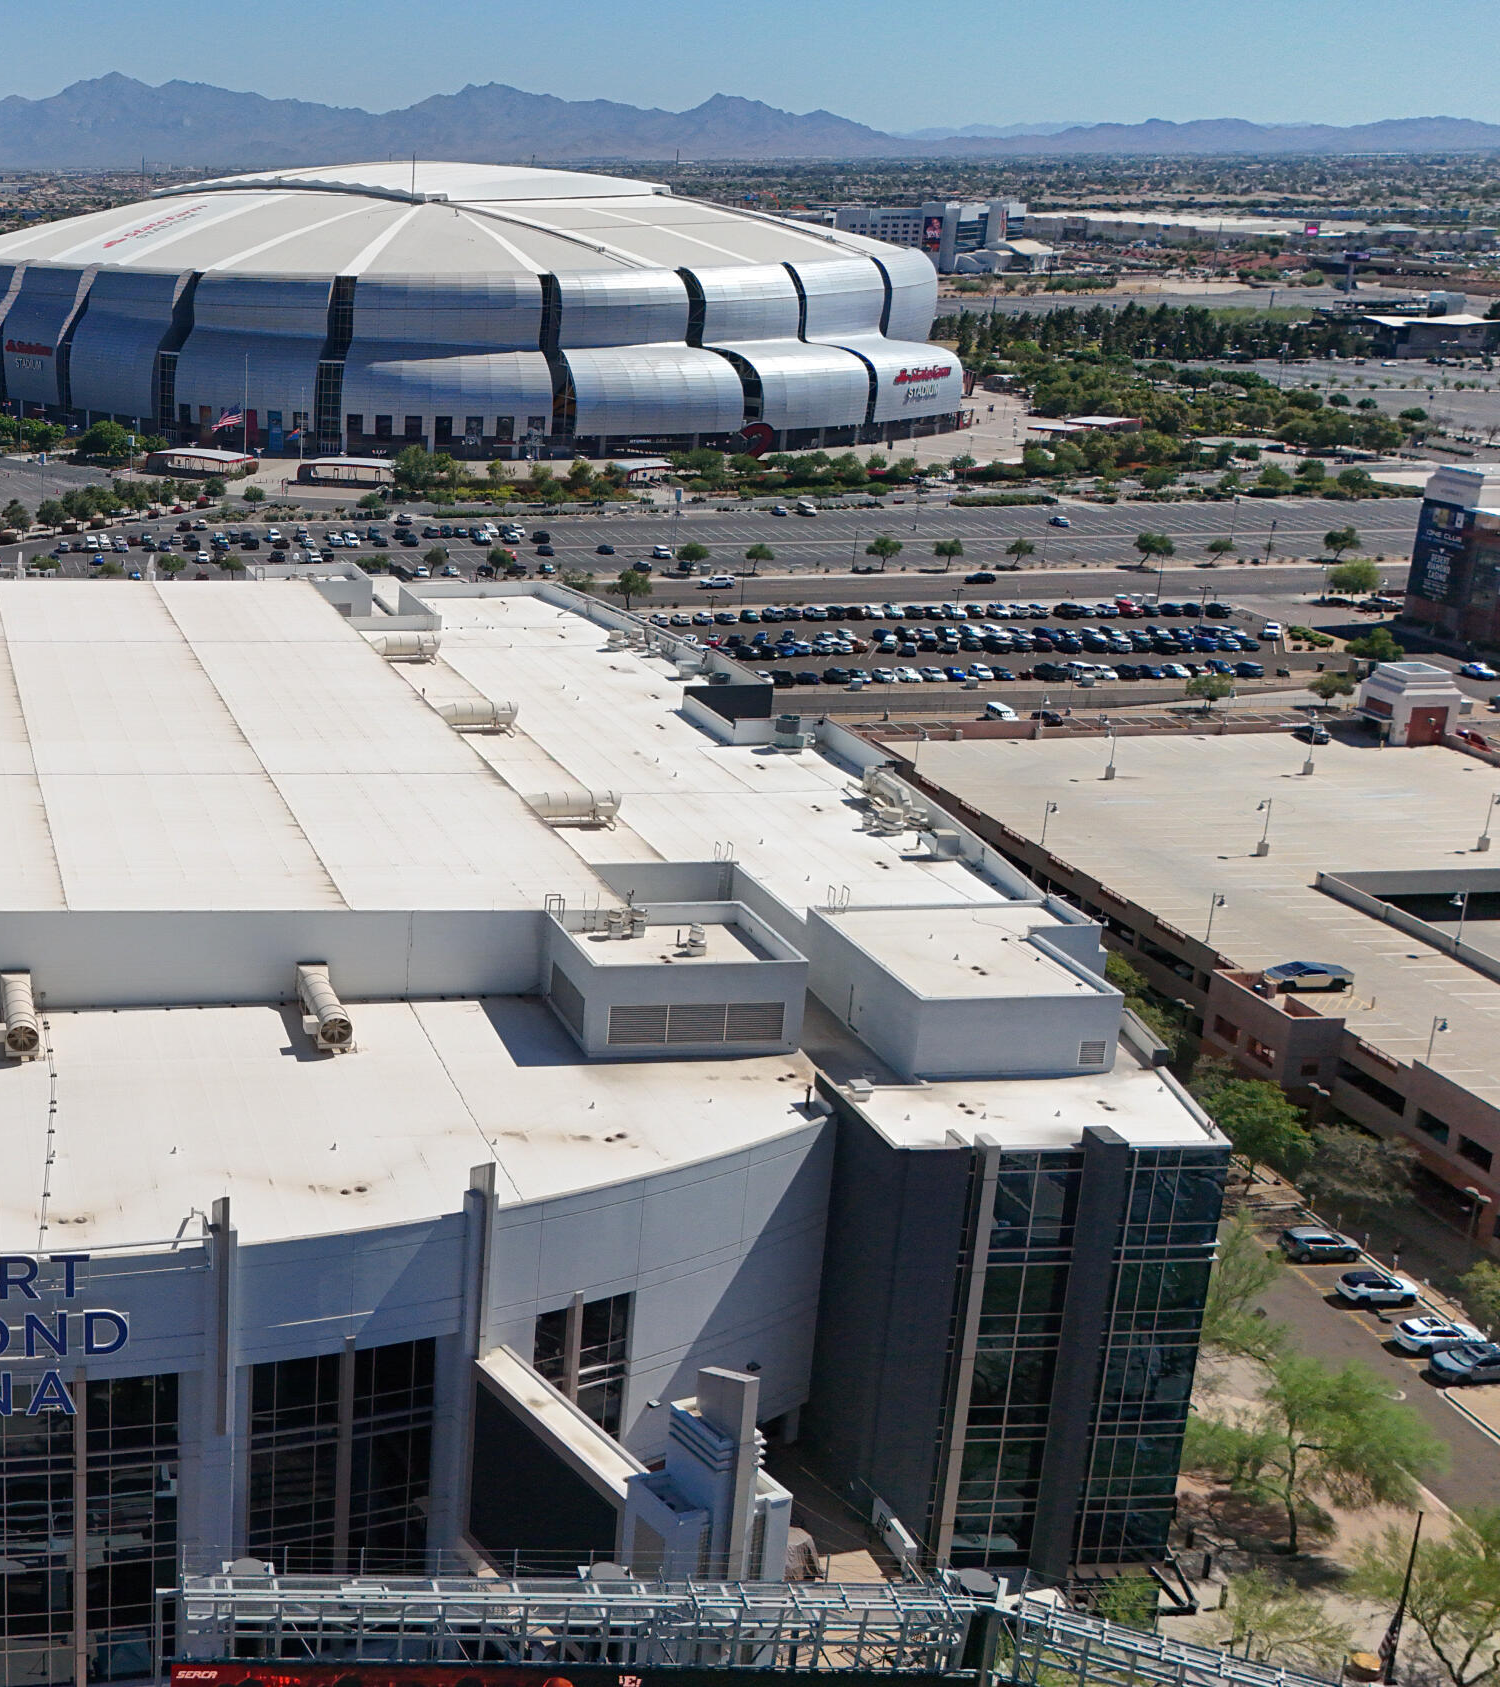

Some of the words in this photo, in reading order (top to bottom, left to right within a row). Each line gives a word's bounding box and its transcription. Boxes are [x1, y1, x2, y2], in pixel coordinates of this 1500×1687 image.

[15, 358, 42, 370] STADIUM
[907, 384, 940, 398] STADIUM
[1426, 529, 1442, 538] ONE
